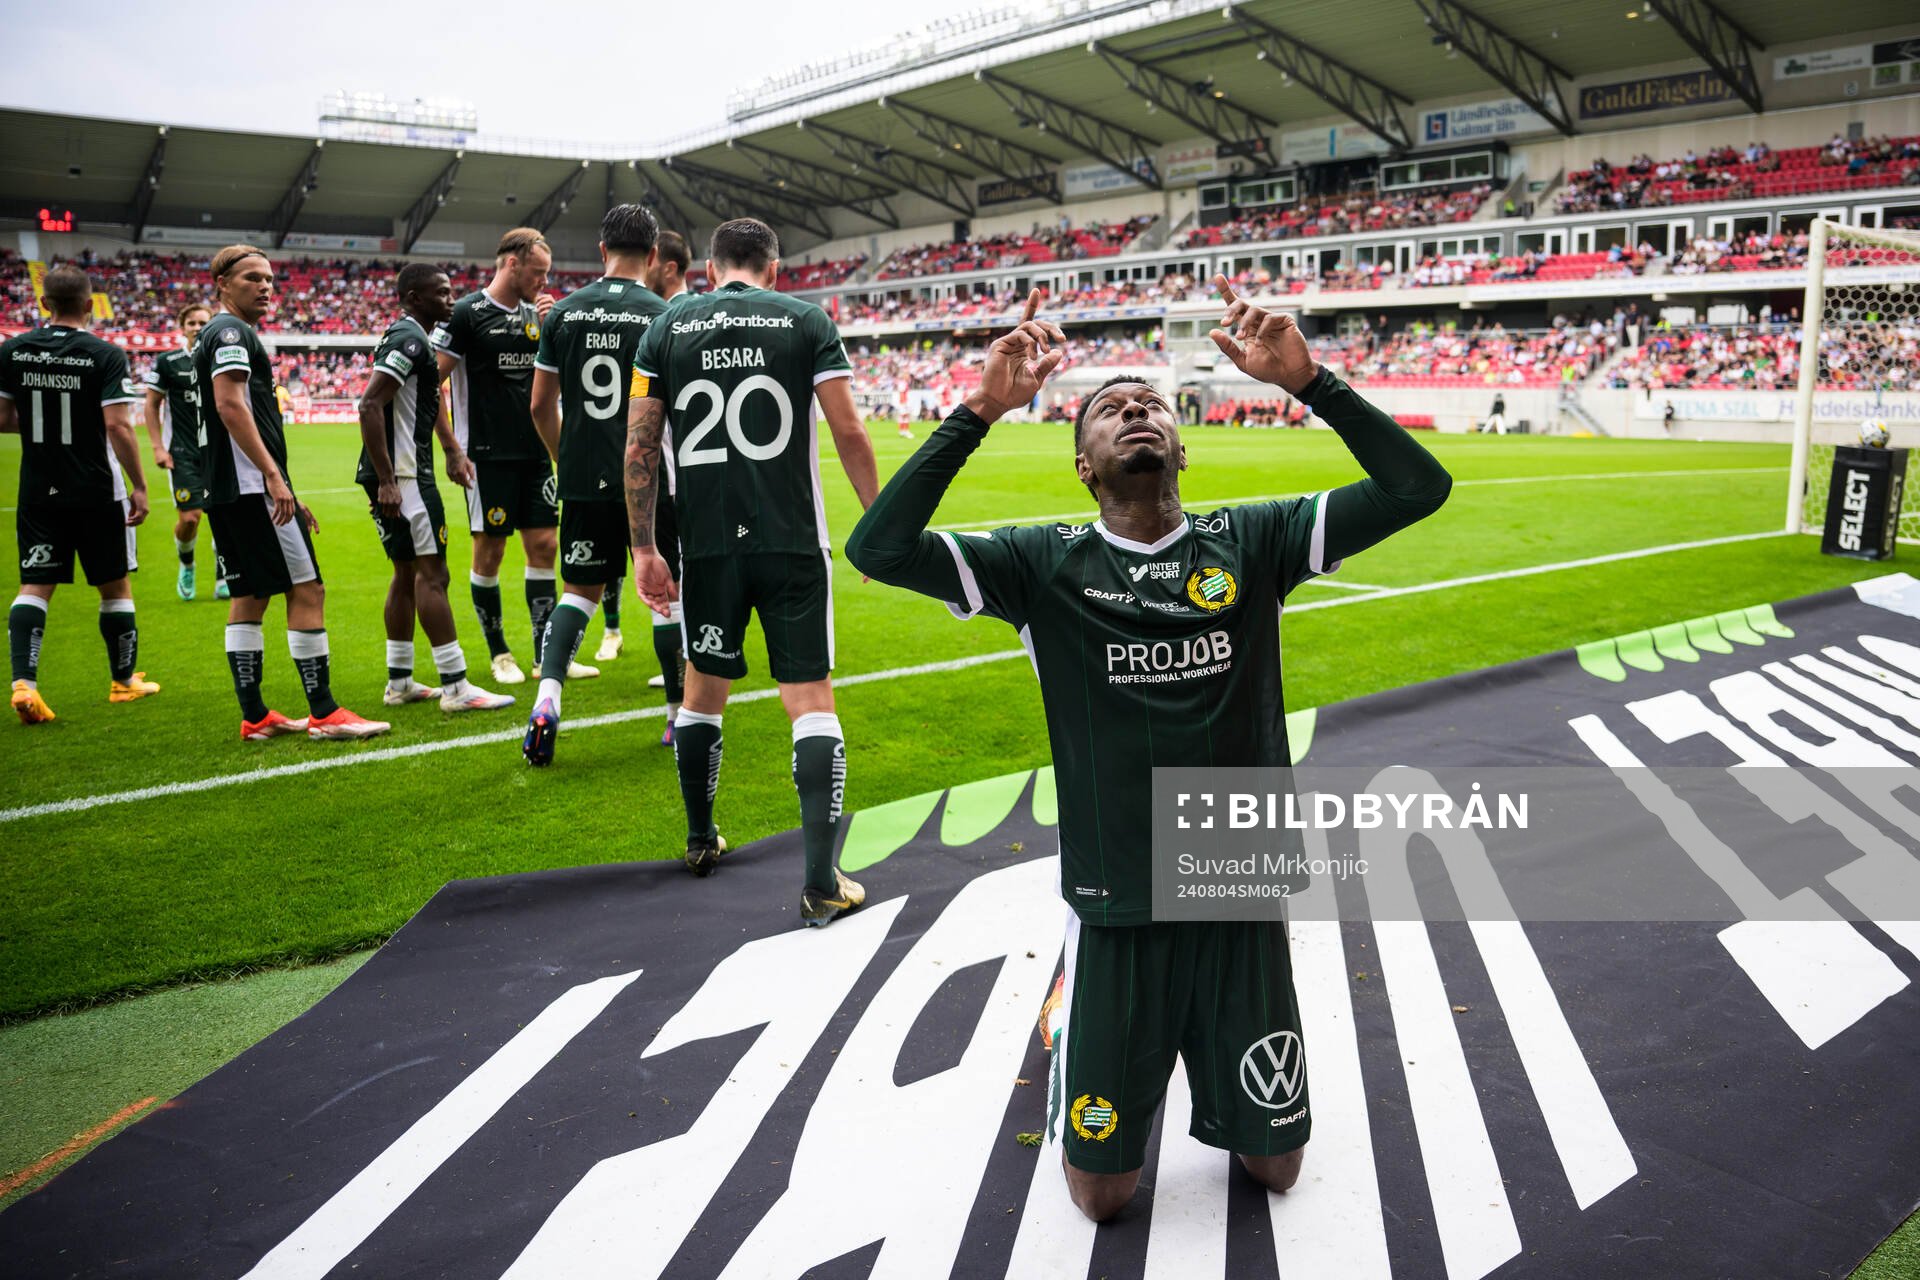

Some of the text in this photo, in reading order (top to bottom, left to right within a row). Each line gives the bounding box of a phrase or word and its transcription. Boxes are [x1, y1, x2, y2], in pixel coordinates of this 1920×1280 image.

[563, 308, 653, 326] Sefina pantbank
[672, 314, 794, 335] Sefina pantbank
[586, 332, 621, 350] ERABI
[12, 350, 95, 368] Sefina pantbank
[701, 346, 766, 371] BESARA
[21, 371, 82, 390] JOHANSSON
[581, 354, 622, 420] 9
[31, 390, 73, 446] 11
[674, 374, 794, 467] 20
[1838, 468, 1871, 551] SELECT
[1149, 561, 1181, 572] INTER
[1149, 570, 1181, 580] SPORT
[1083, 588, 1126, 603] CRAFT
[1106, 630, 1233, 673] PROJOB
[1108, 660, 1233, 685] PROFESSIONAL WORKWEAR
[1270, 1111, 1303, 1127] CRAFT
